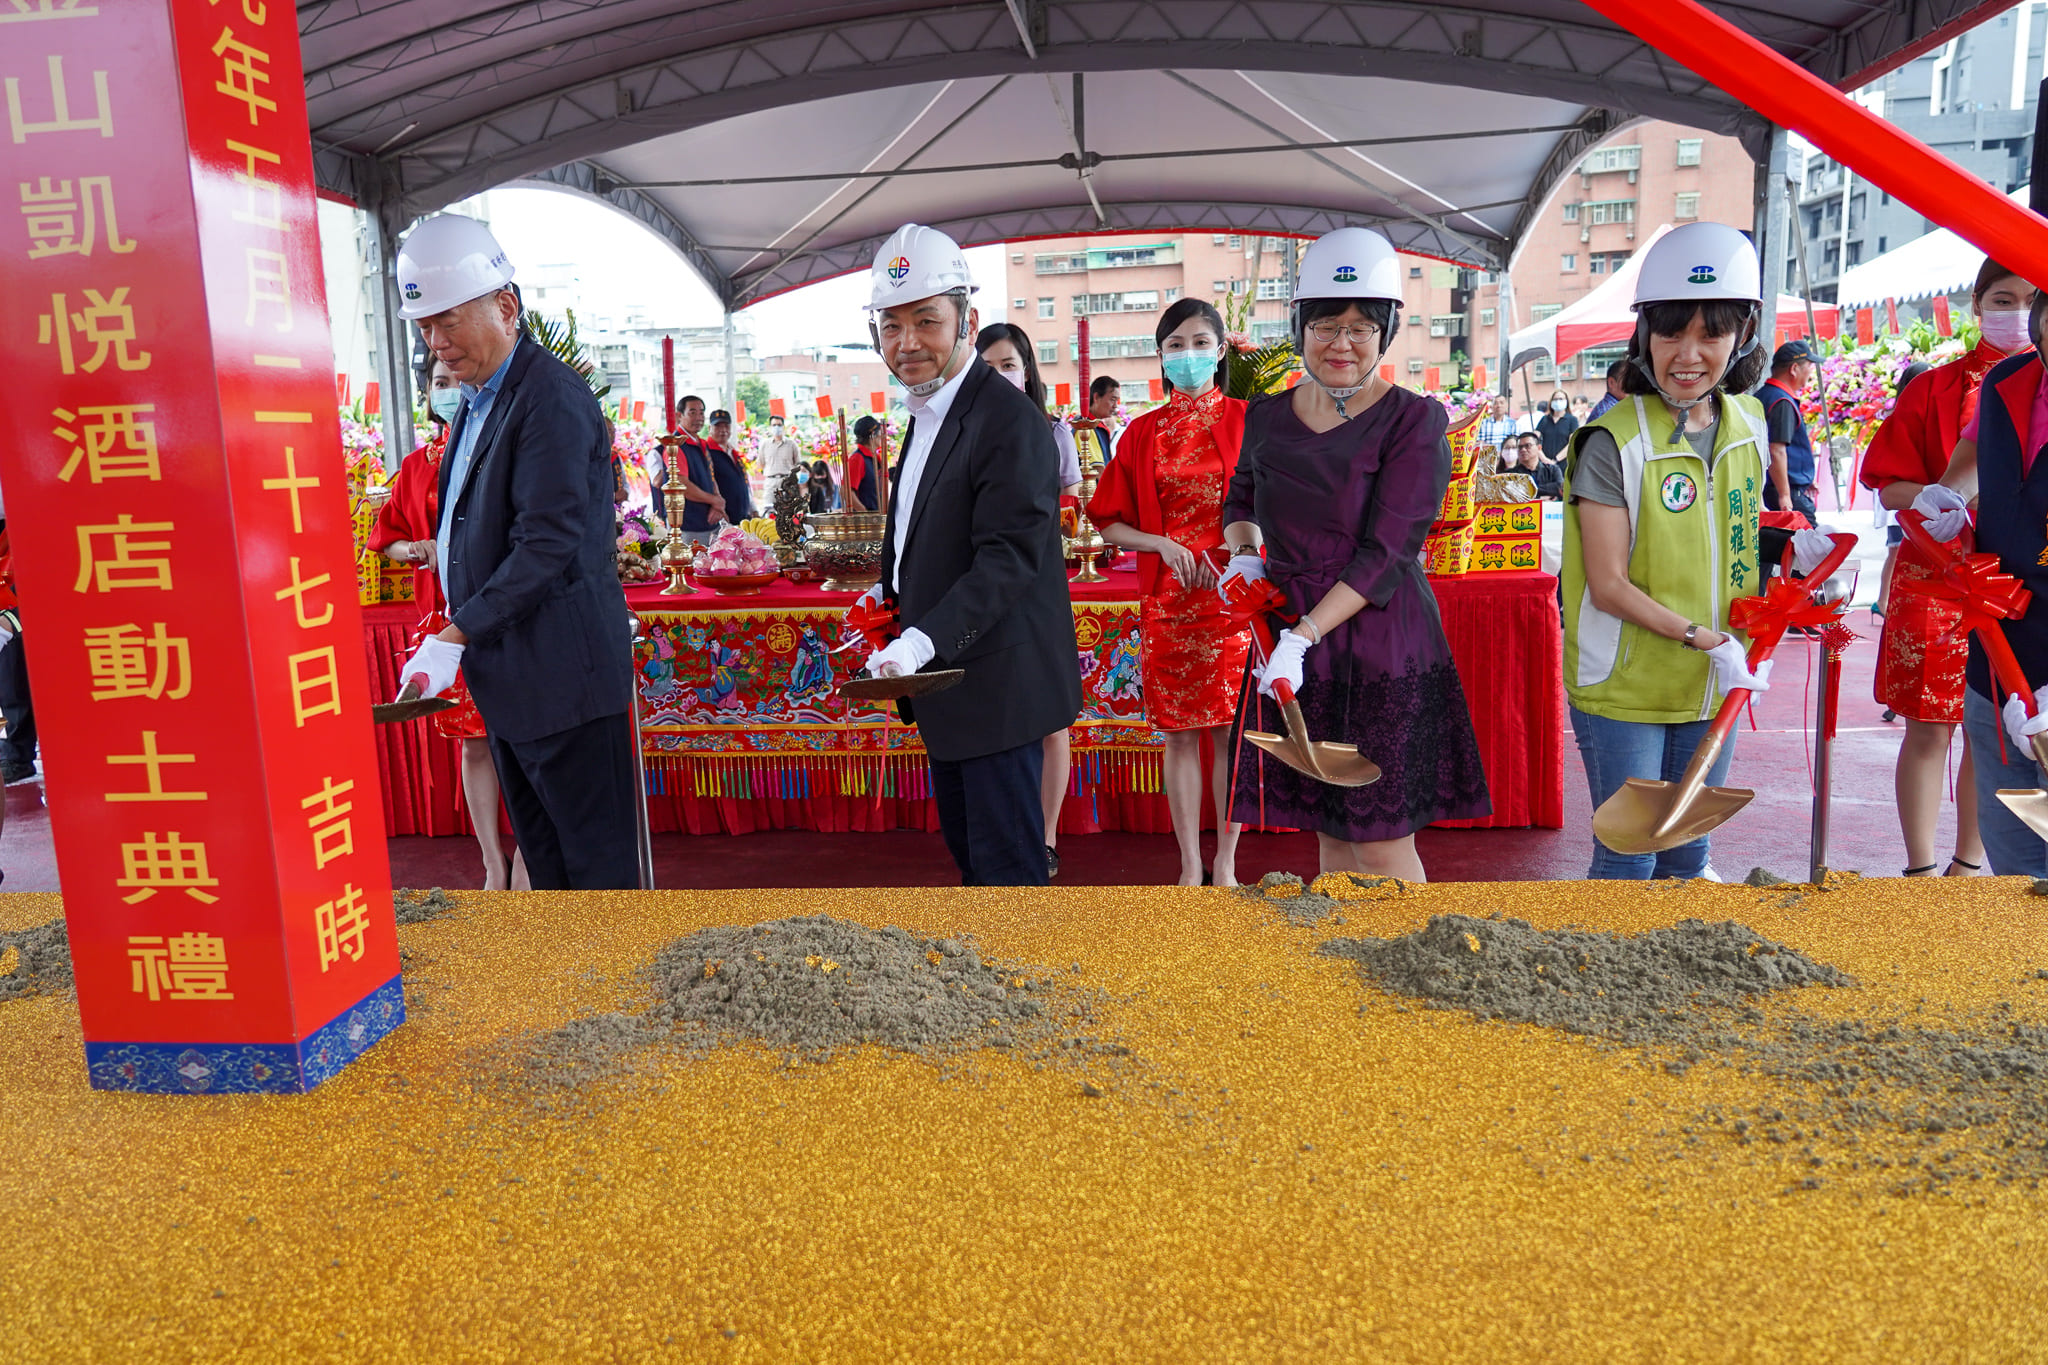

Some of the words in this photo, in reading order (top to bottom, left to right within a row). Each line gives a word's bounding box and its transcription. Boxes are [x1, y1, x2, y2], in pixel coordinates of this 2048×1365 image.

[210, 0, 343, 728] 年五月二十七日
[301, 776, 371, 973] 吉時
[1480, 506, 1537, 533] 興旺
[1728, 488, 1751, 590] 周雅玲
[1075, 617, 1099, 643] 金
